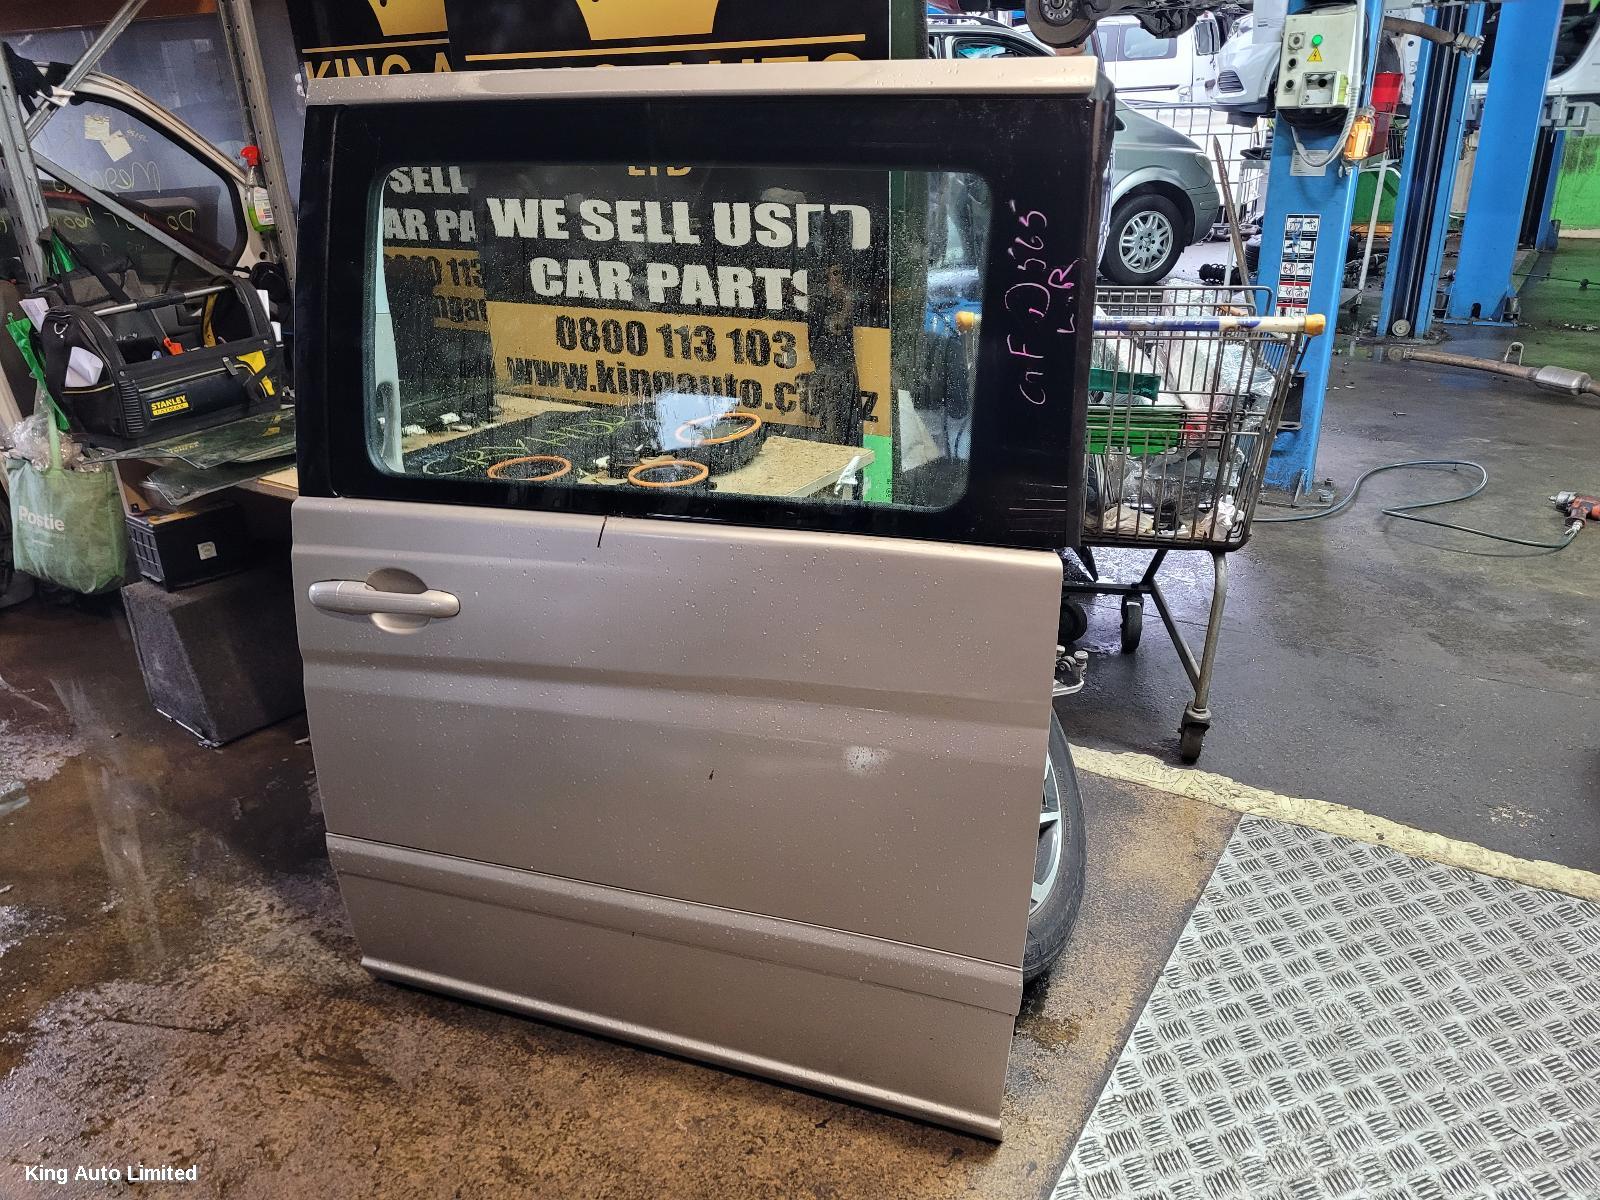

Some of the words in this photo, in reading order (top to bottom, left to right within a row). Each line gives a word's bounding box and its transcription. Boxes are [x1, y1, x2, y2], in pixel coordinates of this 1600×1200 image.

[389, 166, 469, 194] SELL
[487, 198, 570, 240] WE
[580, 199, 701, 244] SELL
[529, 256, 634, 301] CAR
[555, 314, 648, 357] 0800
[656, 322, 717, 363] 113
[725, 327, 797, 370] 103
[151, 395, 187, 411] STANLEY
[18, 505, 65, 532] Postie
